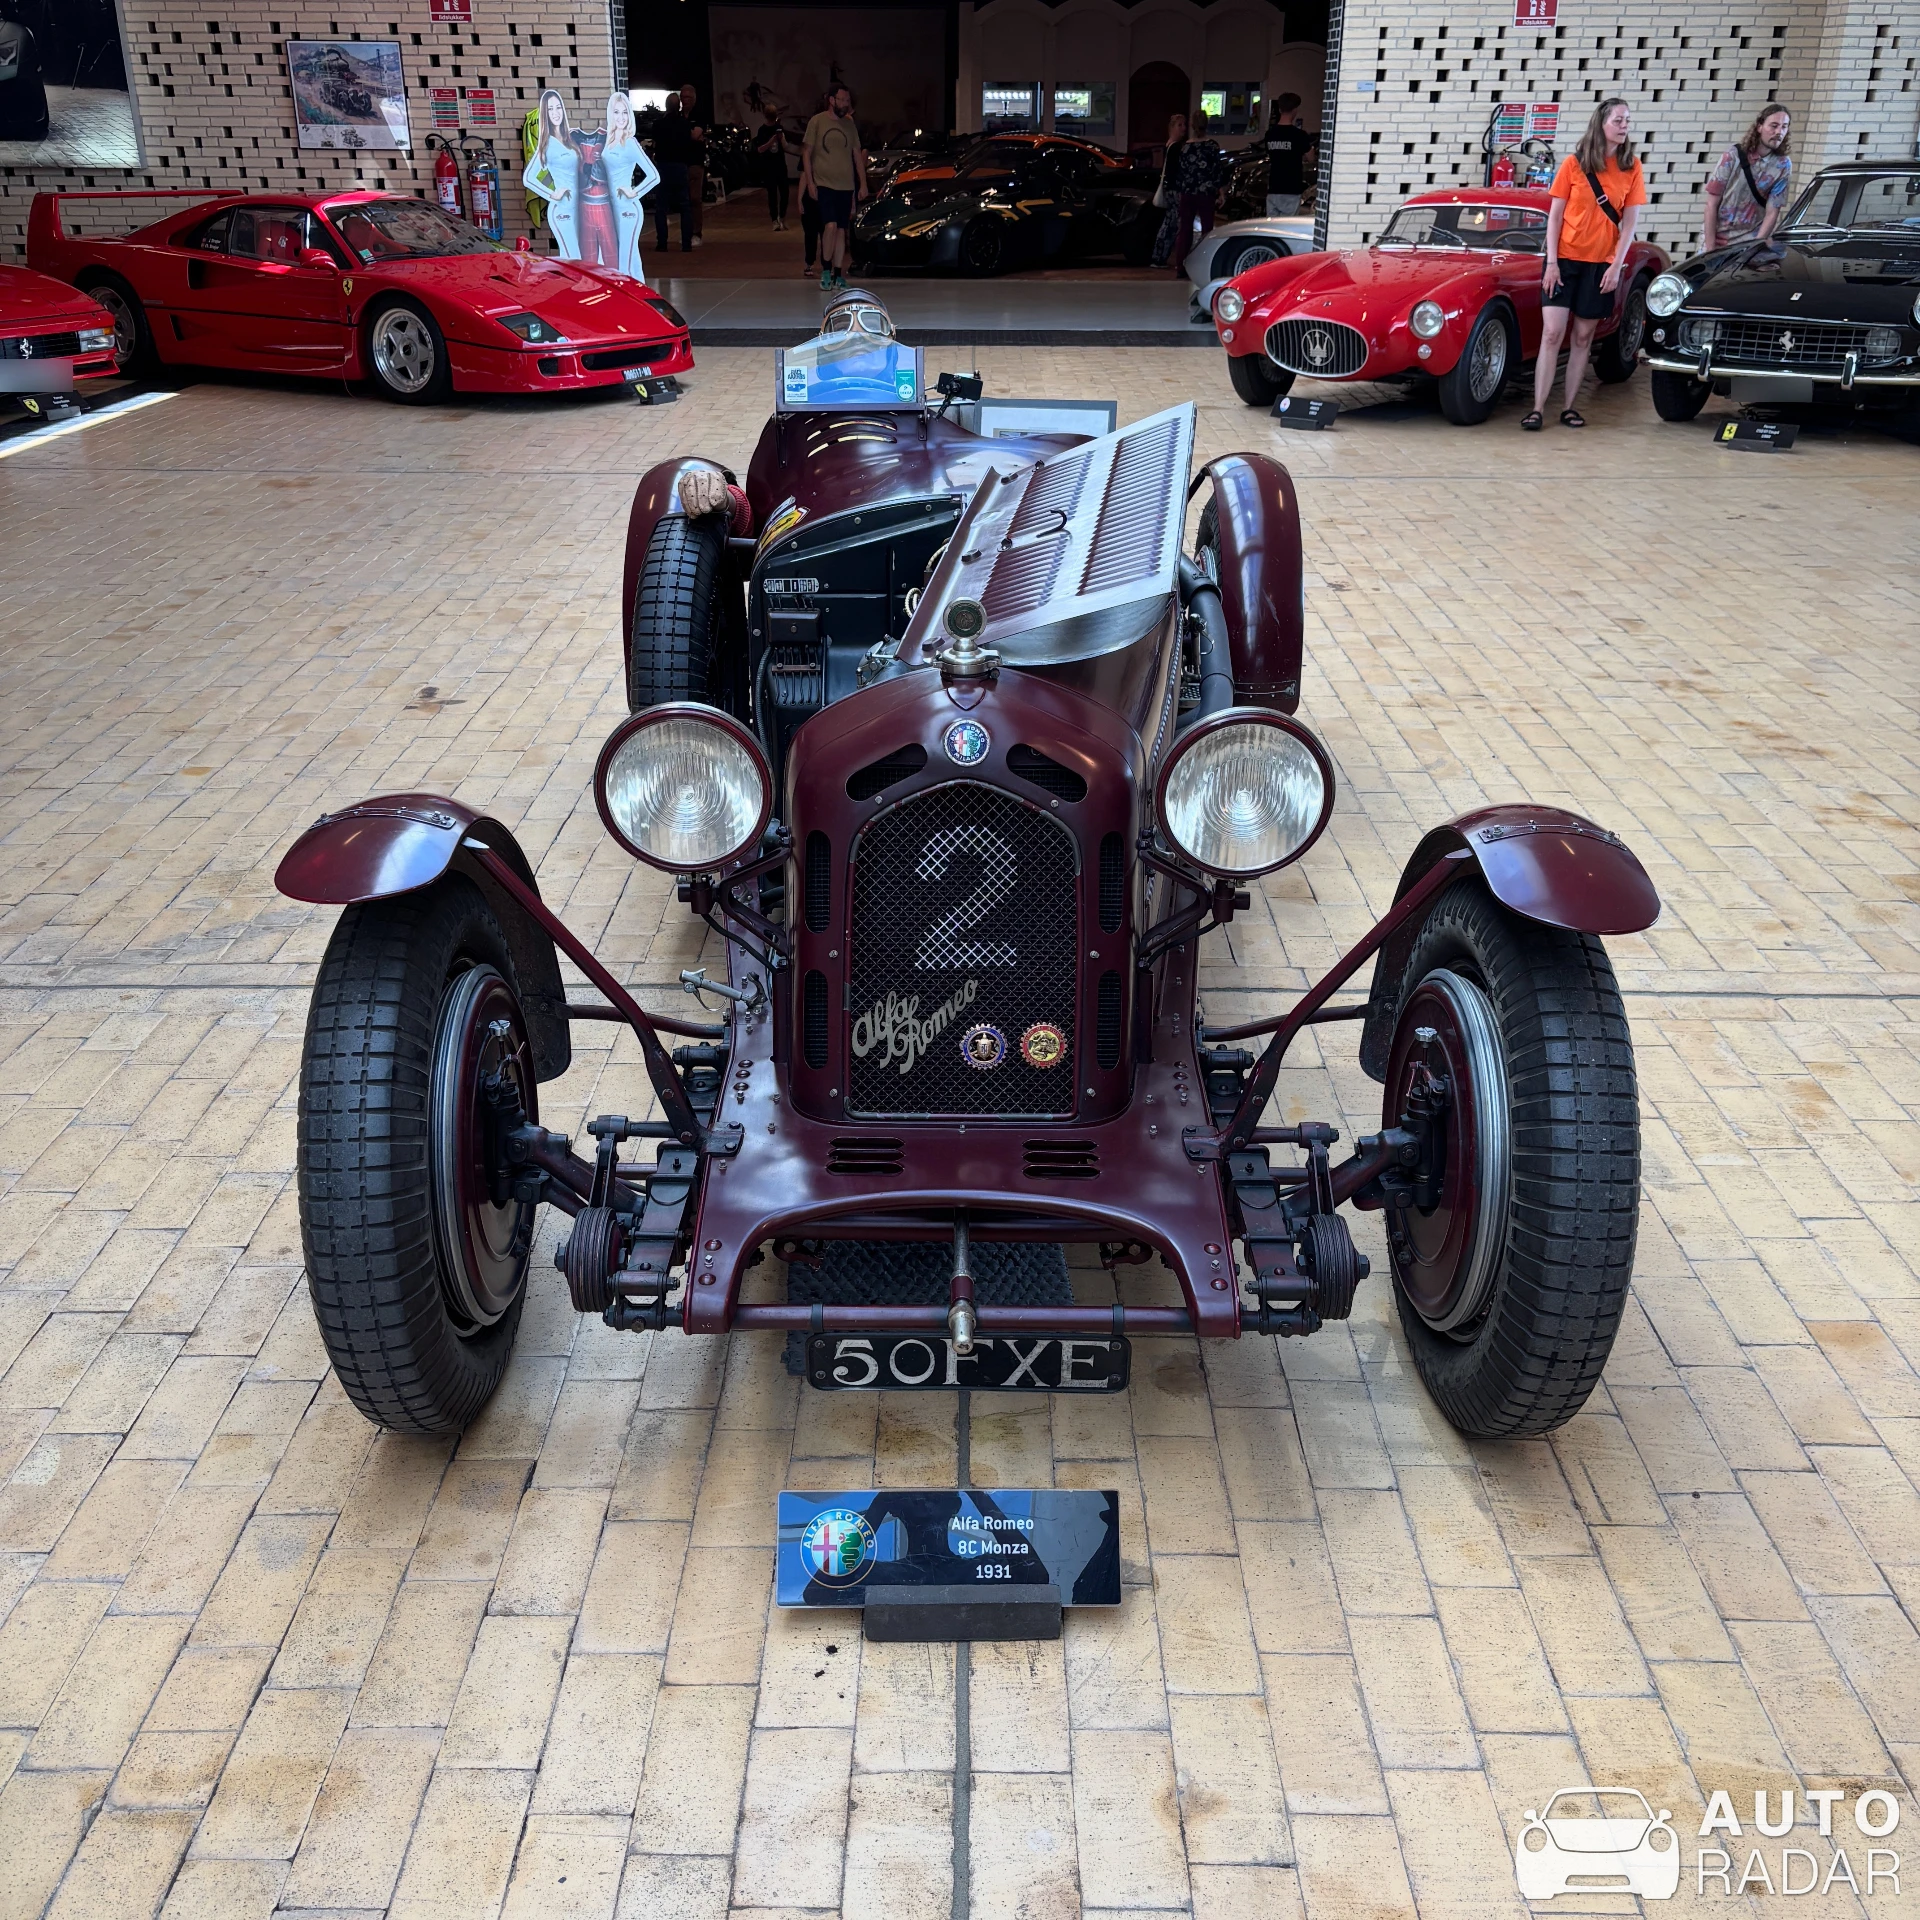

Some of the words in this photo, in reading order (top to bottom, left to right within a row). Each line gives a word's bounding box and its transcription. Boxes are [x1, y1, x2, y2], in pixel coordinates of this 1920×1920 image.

[950, 727, 963, 742] ALFA
[966, 726, 985, 743] ROMEO
[954, 753, 979, 761] MILANO
[915, 825, 1018, 970] 2
[852, 990, 920, 1069] Alfa
[890, 979, 978, 1074] Romeo
[804, 1517, 826, 1549] ALFA
[835, 1511, 875, 1549] ROMEO
[951, 1517, 981, 1531] Alfa
[983, 1517, 1034, 1531] Romeo
[958, 1541, 977, 1555] 8C
[981, 1541, 1029, 1555] Monza
[975, 1564, 1012, 1579] 1931
